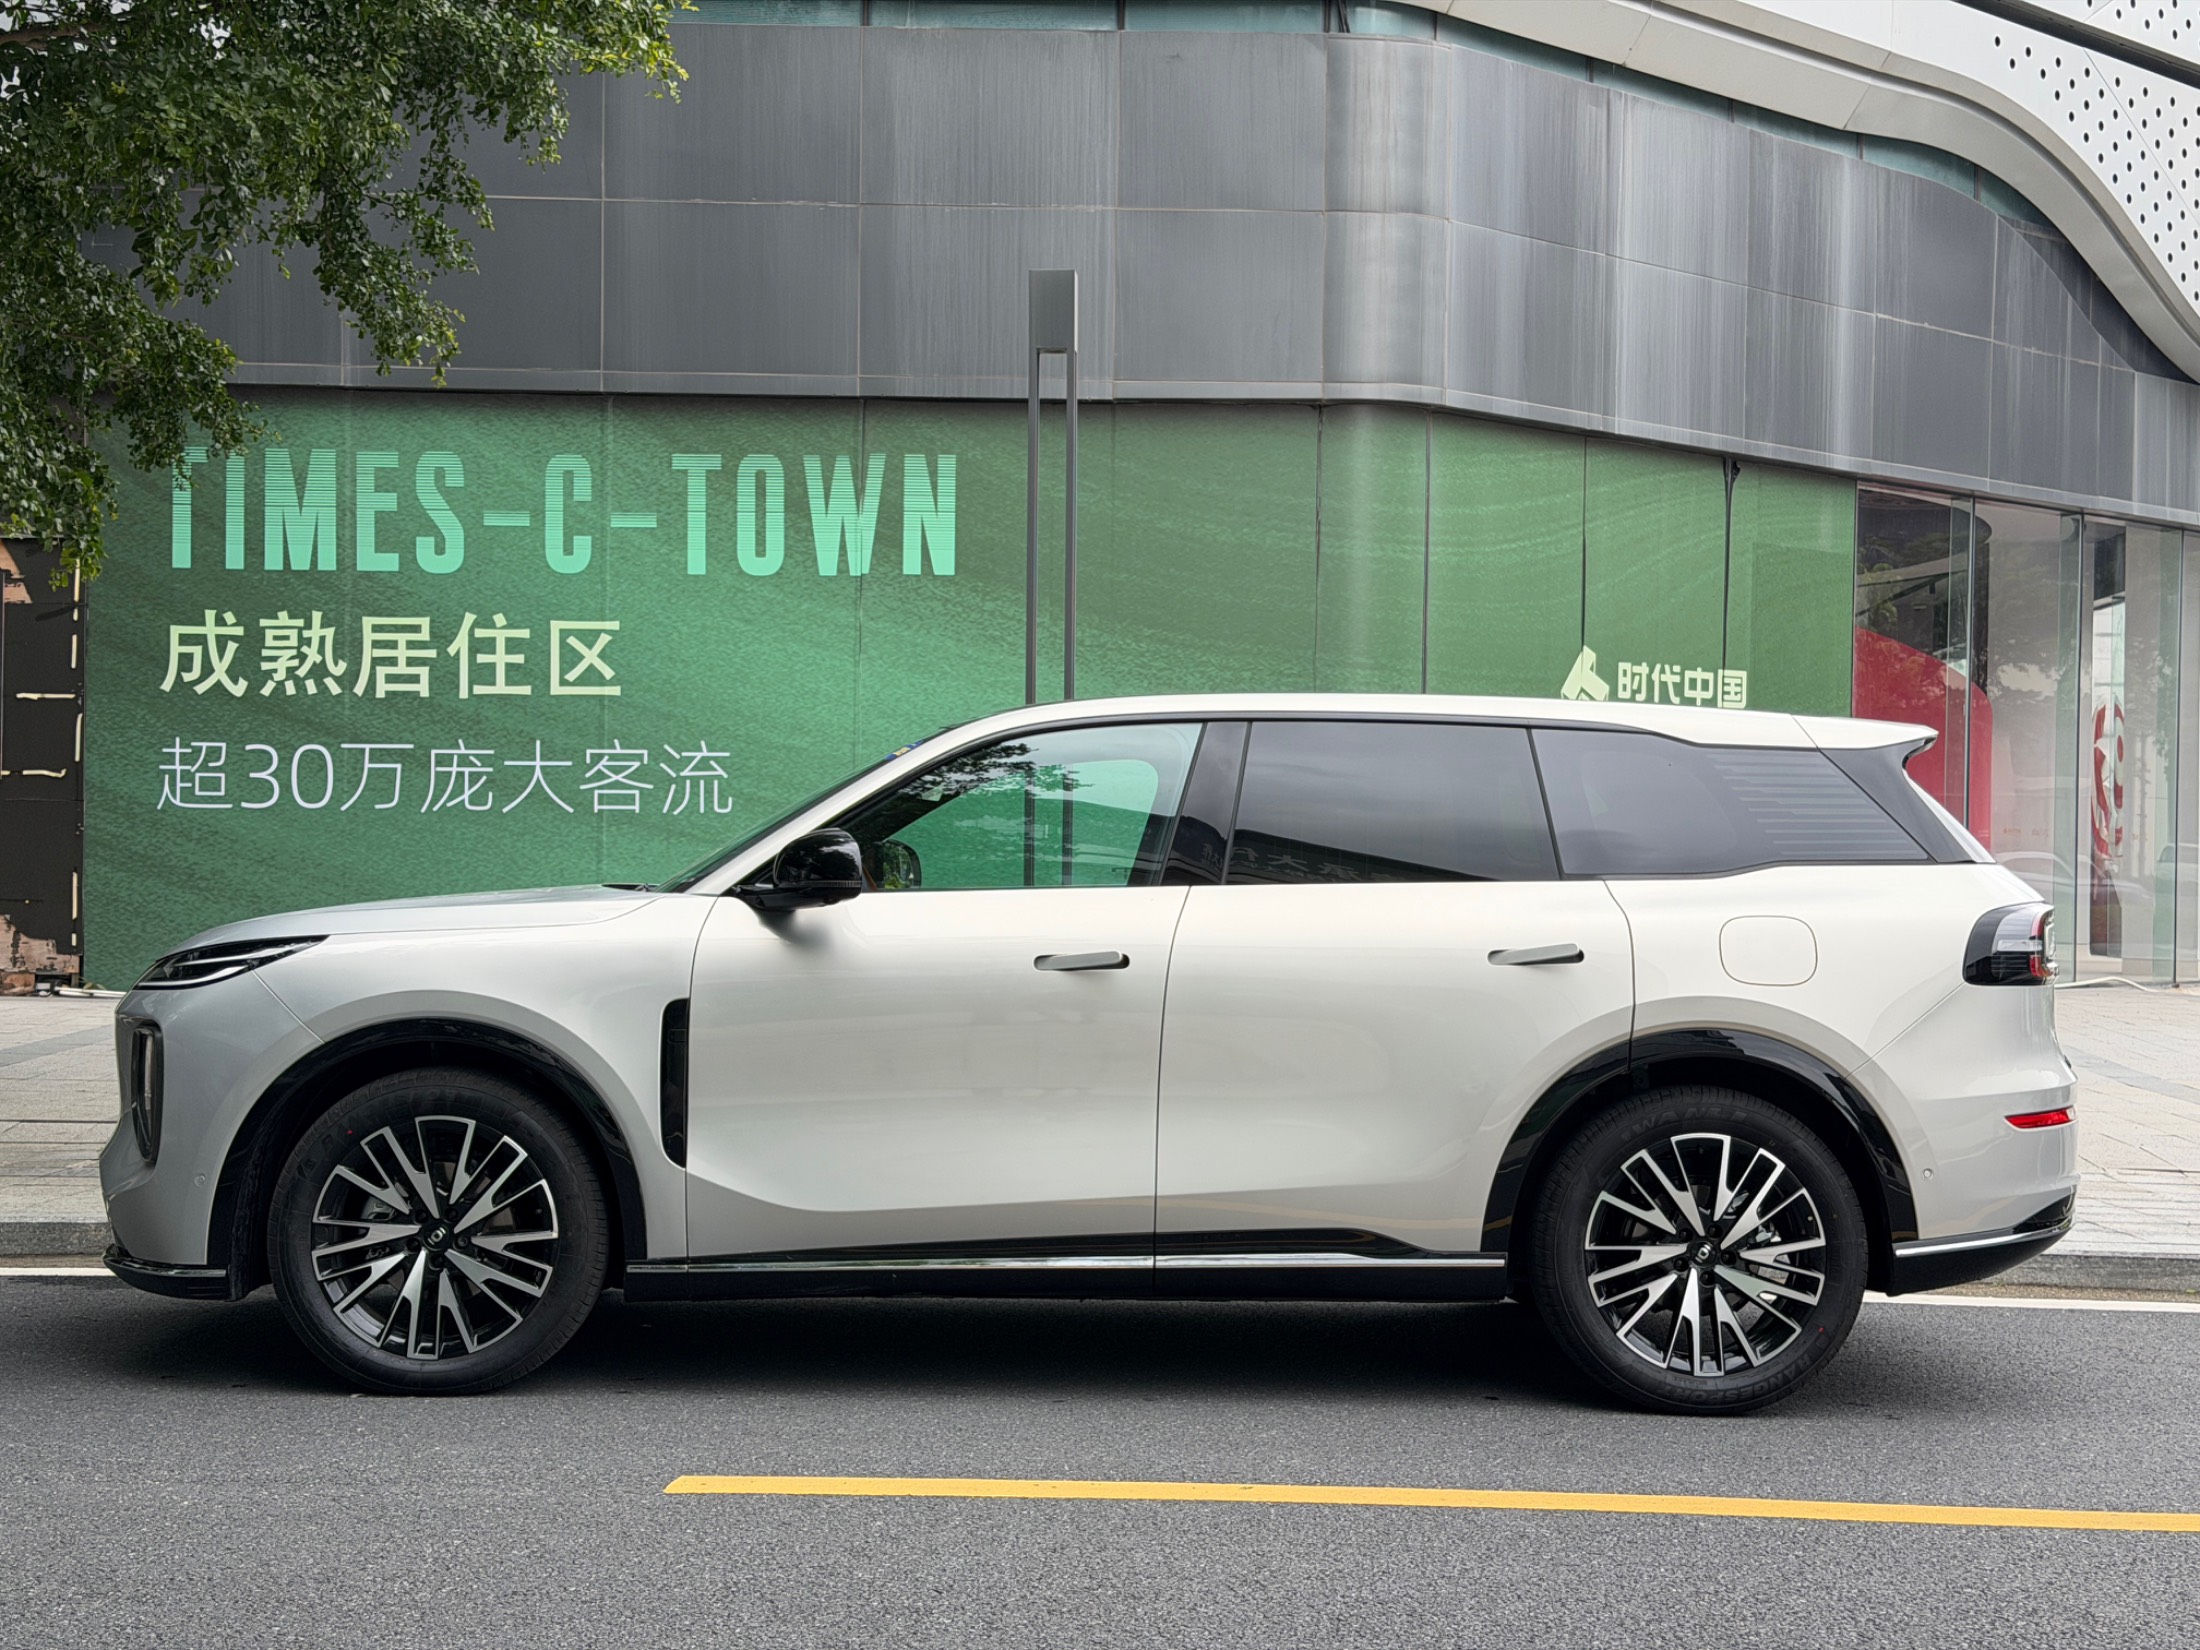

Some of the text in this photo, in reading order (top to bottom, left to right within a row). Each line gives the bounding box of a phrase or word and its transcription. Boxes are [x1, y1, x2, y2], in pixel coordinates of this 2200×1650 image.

[168, 447, 958, 577] TIMES-C-TOWN
[159, 608, 622, 700] 成熟居住区
[1617, 661, 1748, 710] 时代中国
[156, 736, 734, 816] 超30万庞大客流
